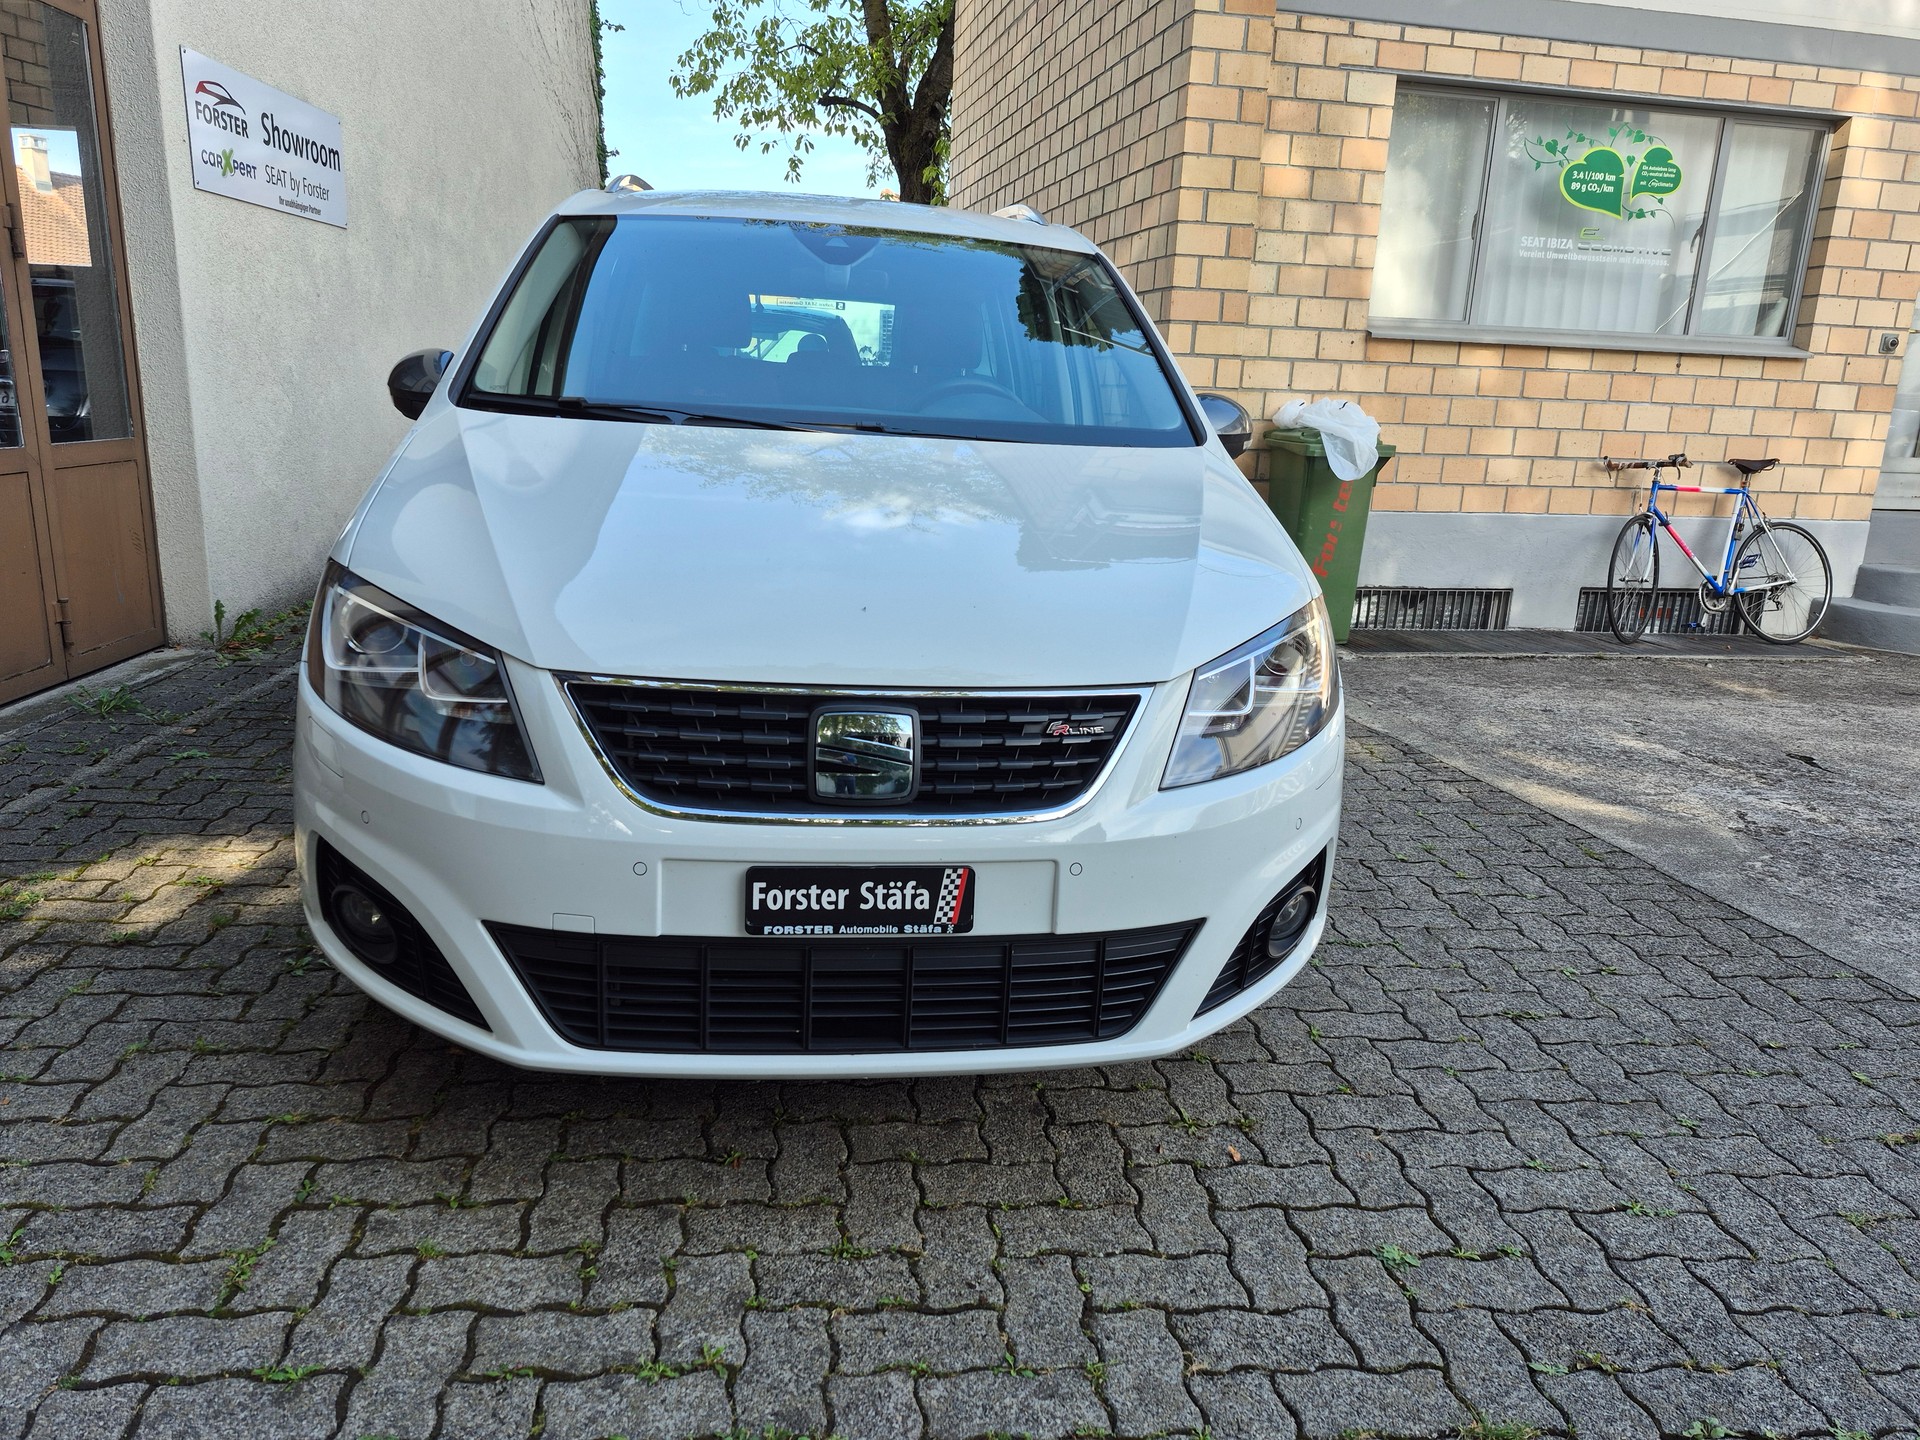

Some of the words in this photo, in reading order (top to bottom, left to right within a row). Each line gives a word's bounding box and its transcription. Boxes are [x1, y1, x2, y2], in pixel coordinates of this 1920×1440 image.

[195, 100, 249, 139] FORSTER
[260, 112, 341, 172] Showroom
[265, 164, 288, 188] SEAT
[290, 172, 301, 197] by
[303, 177, 330, 201] Forster
[1572, 170, 1584, 180] 3.4
[1585, 170, 1604, 181] l/100
[1605, 172, 1616, 182] km
[1570, 182, 1581, 191] 89
[1581, 184, 1587, 193] g
[1520, 235, 1546, 248] SEAT
[1547, 237, 1574, 250] IBIZA
[1518, 248, 1545, 259] Vereint
[1546, 250, 1618, 263] Umweltbewusstsein
[1618, 256, 1631, 265] mit
[1312, 480, 1354, 577] Forste
[1069, 726, 1105, 735] LINE
[752, 881, 850, 911] Forster
[859, 881, 930, 911] Stäfa
[763, 925, 834, 935] FORSTER
[838, 925, 899, 935] Automobile
[903, 924, 942, 935] Stäfa
